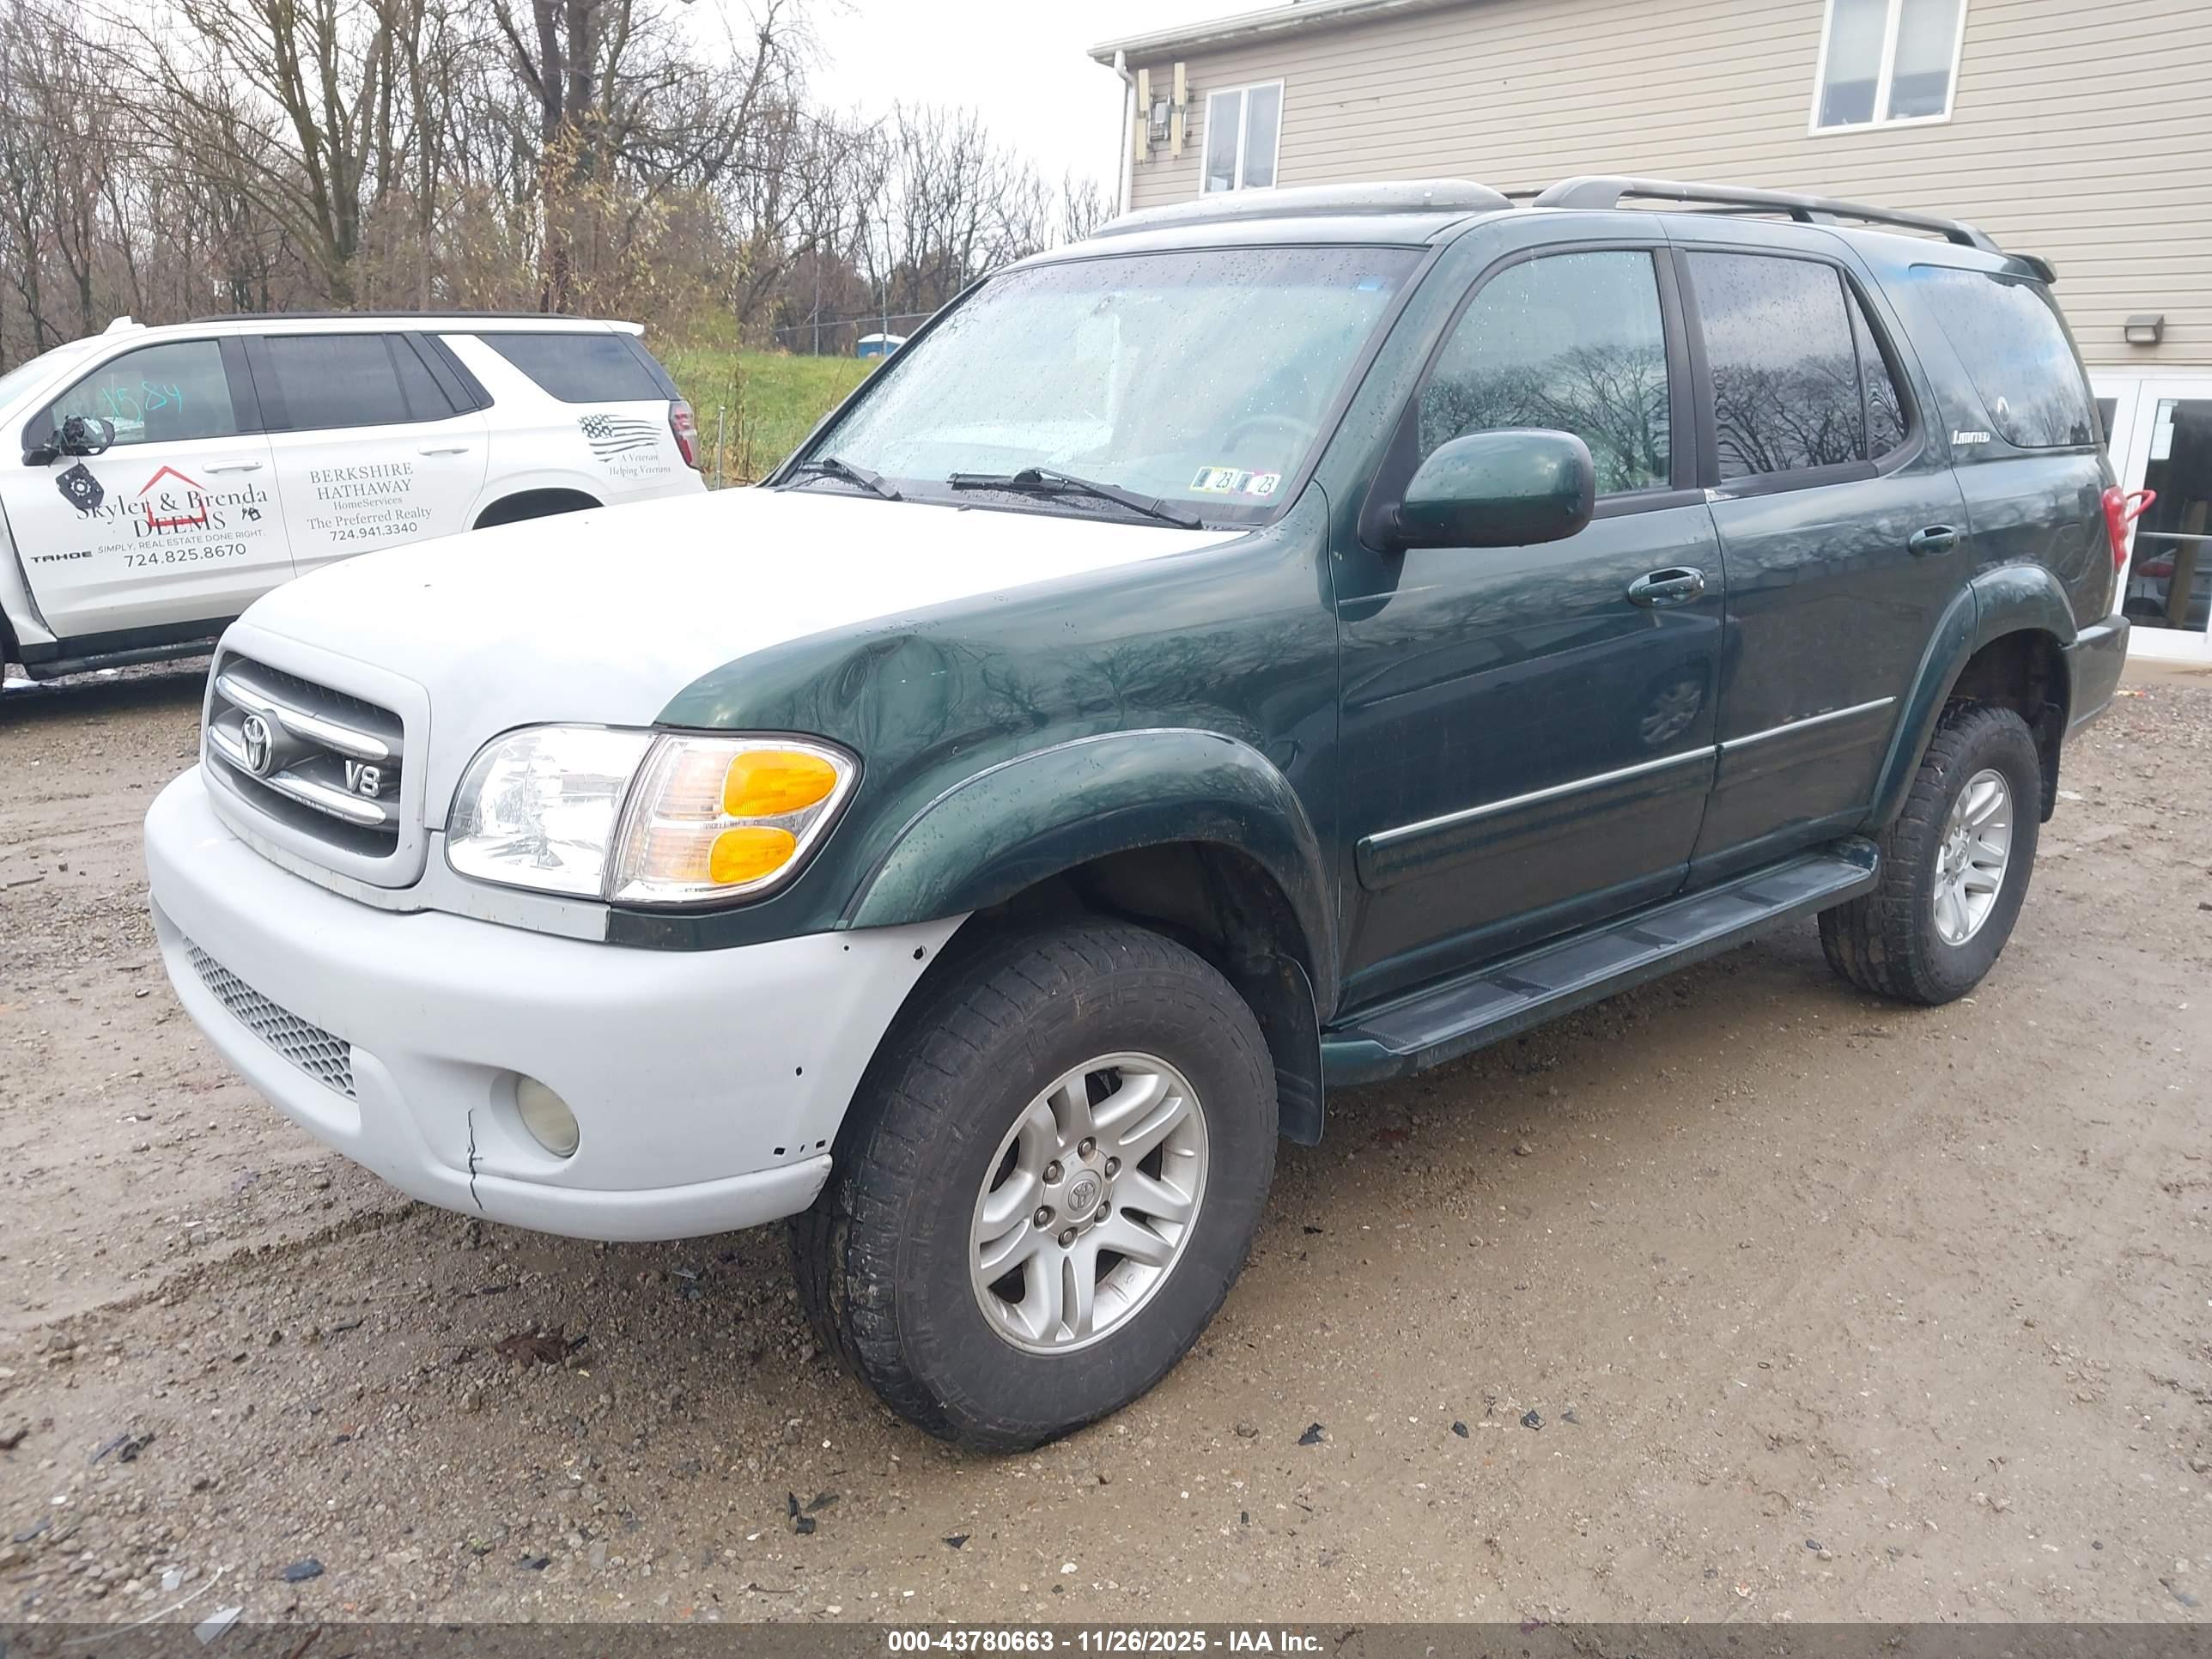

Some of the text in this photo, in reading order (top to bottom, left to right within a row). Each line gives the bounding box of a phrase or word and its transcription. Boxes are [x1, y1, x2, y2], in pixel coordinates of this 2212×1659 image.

[629, 453, 659, 462] Veteran
[309, 461, 414, 484] BERKSHIRE
[610, 466, 638, 478] Helping
[1216, 471, 1233, 489] 23
[316, 478, 412, 501] HATHAWAY
[1258, 476, 1275, 494] 23
[159, 492, 180, 513] &
[186, 483, 269, 510] Brenda
[333, 495, 403, 511] HomeServices
[133, 510, 227, 538] DEEMS
[307, 506, 433, 530] The Preferred Realty
[97, 528, 266, 555] SIMPLY, REAL ESTATE DONE RIGHT.
[329, 521, 418, 542] 724.941.3340
[30, 550, 93, 563] TAHOE
[123, 543, 247, 568] 724.825.8670
[344, 759, 383, 798] V8
